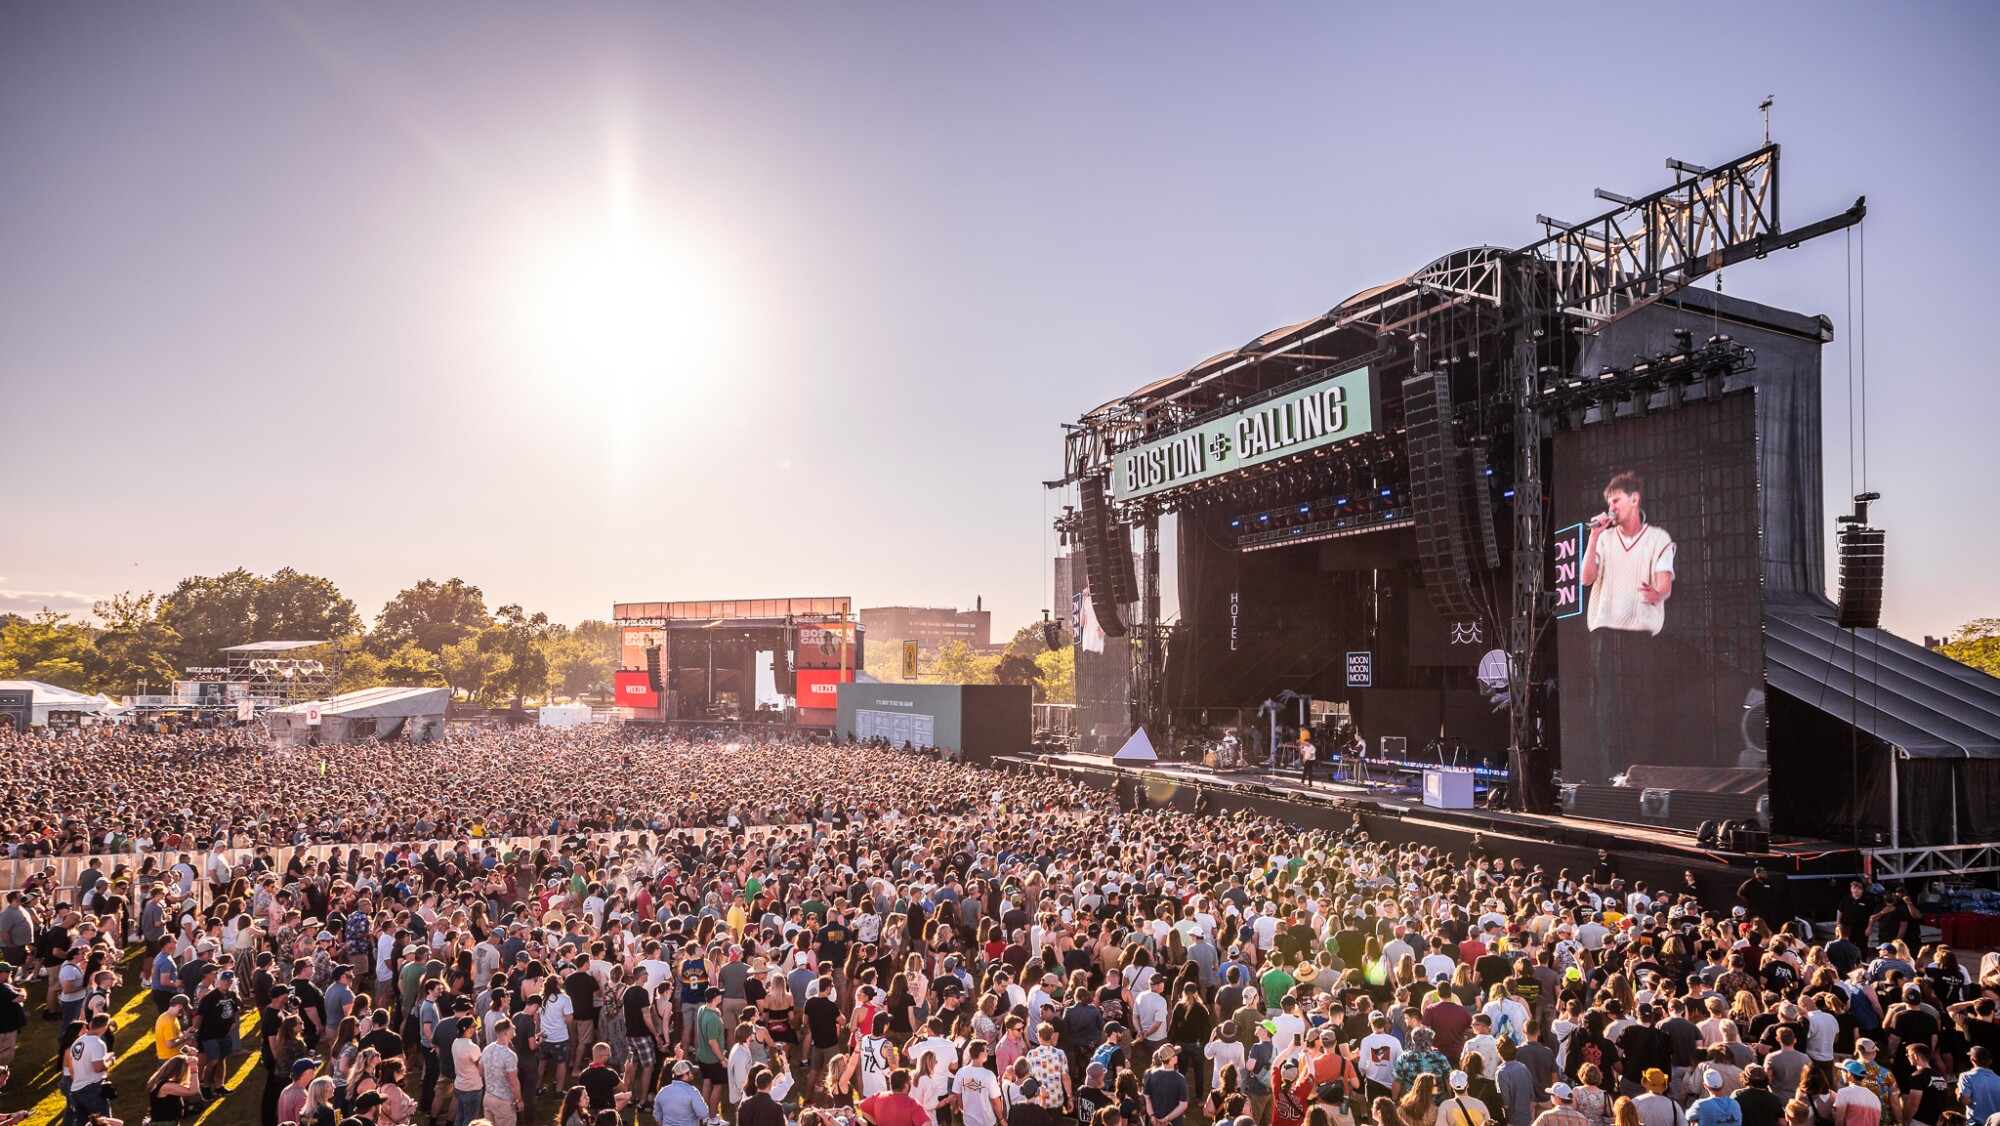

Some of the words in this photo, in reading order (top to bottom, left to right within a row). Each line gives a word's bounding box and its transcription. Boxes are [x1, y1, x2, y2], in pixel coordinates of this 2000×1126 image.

[1125, 434, 1205, 493] BOSTON
[1235, 386, 1346, 460] CALLING
[1230, 592, 1239, 651] HOTEL
[1349, 656, 1369, 664] MOON
[1349, 665, 1369, 673] MOON
[1349, 674, 1369, 682] MOON
[625, 685, 647, 694] WEEZER
[810, 684, 837, 694] WEEZER
[310, 710, 318, 719] D
[689, 975, 699, 990] 2
[863, 1054, 876, 1073] 72
